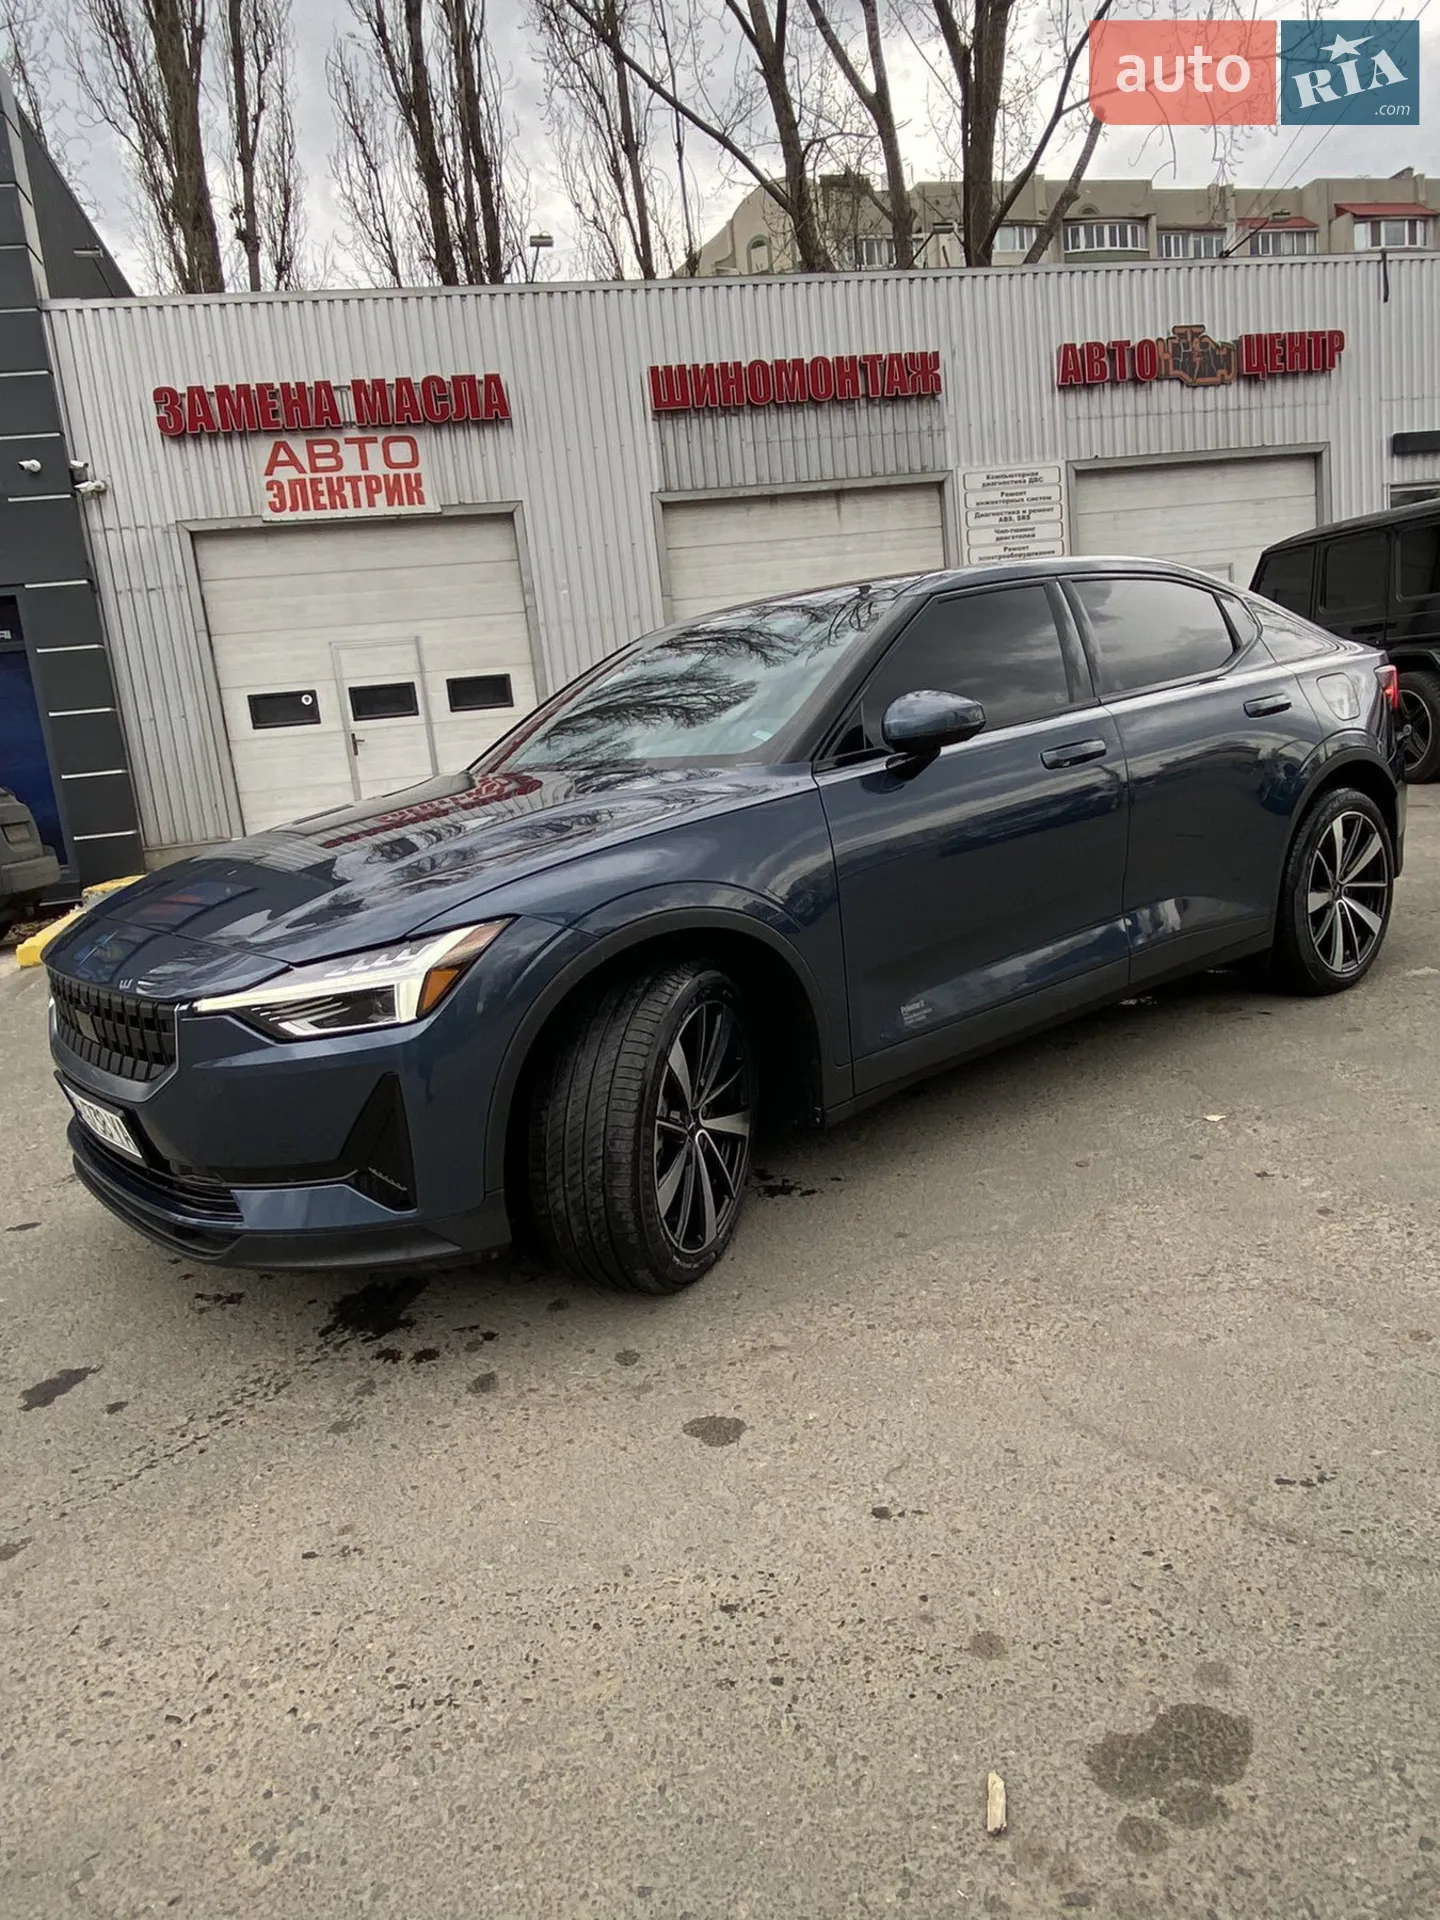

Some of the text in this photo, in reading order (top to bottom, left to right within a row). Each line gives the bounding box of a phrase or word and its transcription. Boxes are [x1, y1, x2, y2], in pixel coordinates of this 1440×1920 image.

[649, 351, 942, 411] ШИНОМОНТАЖ
[1058, 330, 1346, 385] АВТО ЦЕНТР
[153, 373, 512, 437] ЗАМЕНА МАСЛА
[264, 434, 420, 477] АВТО
[265, 472, 427, 514] ЭЛЕКТРИК
[1000, 490, 1027, 498] Ремонт
